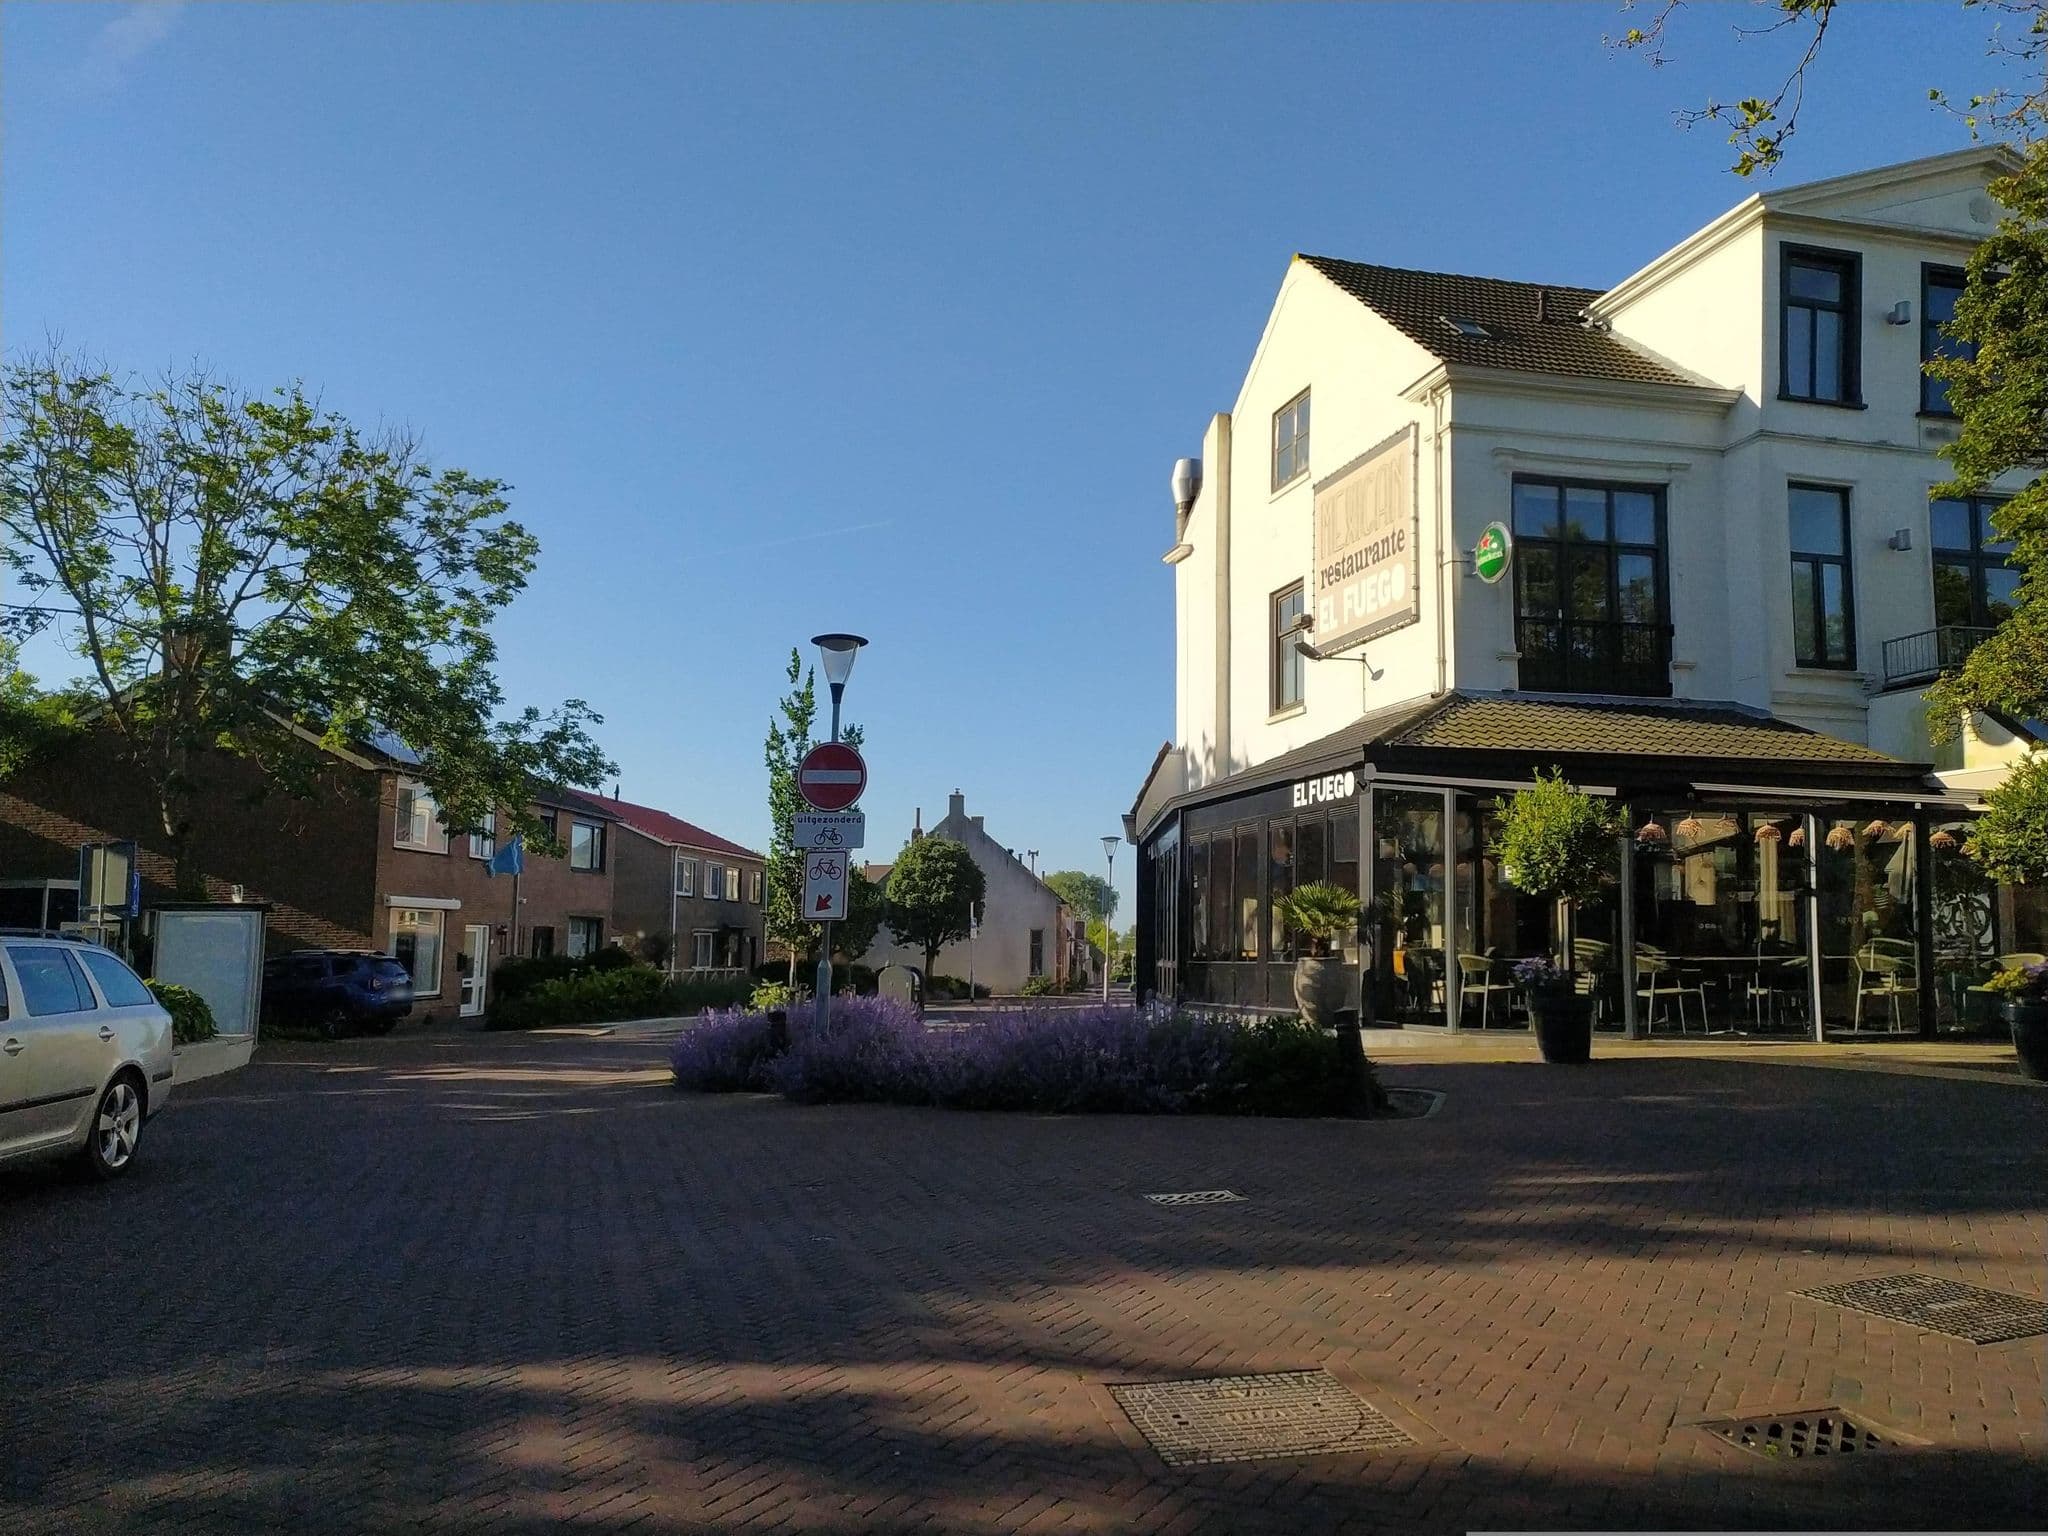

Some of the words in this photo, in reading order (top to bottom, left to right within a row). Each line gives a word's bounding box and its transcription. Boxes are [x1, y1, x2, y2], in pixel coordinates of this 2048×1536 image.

[1320, 454, 1404, 560] MEXICAN
[1320, 527, 1405, 590] restaurante
[1319, 595, 1338, 634] EL
[1343, 562, 1406, 625] FUEGO
[797, 815, 862, 825] uitgezonderd
[1293, 782, 1307, 808] EL
[1309, 771, 1355, 805] FUEGO
